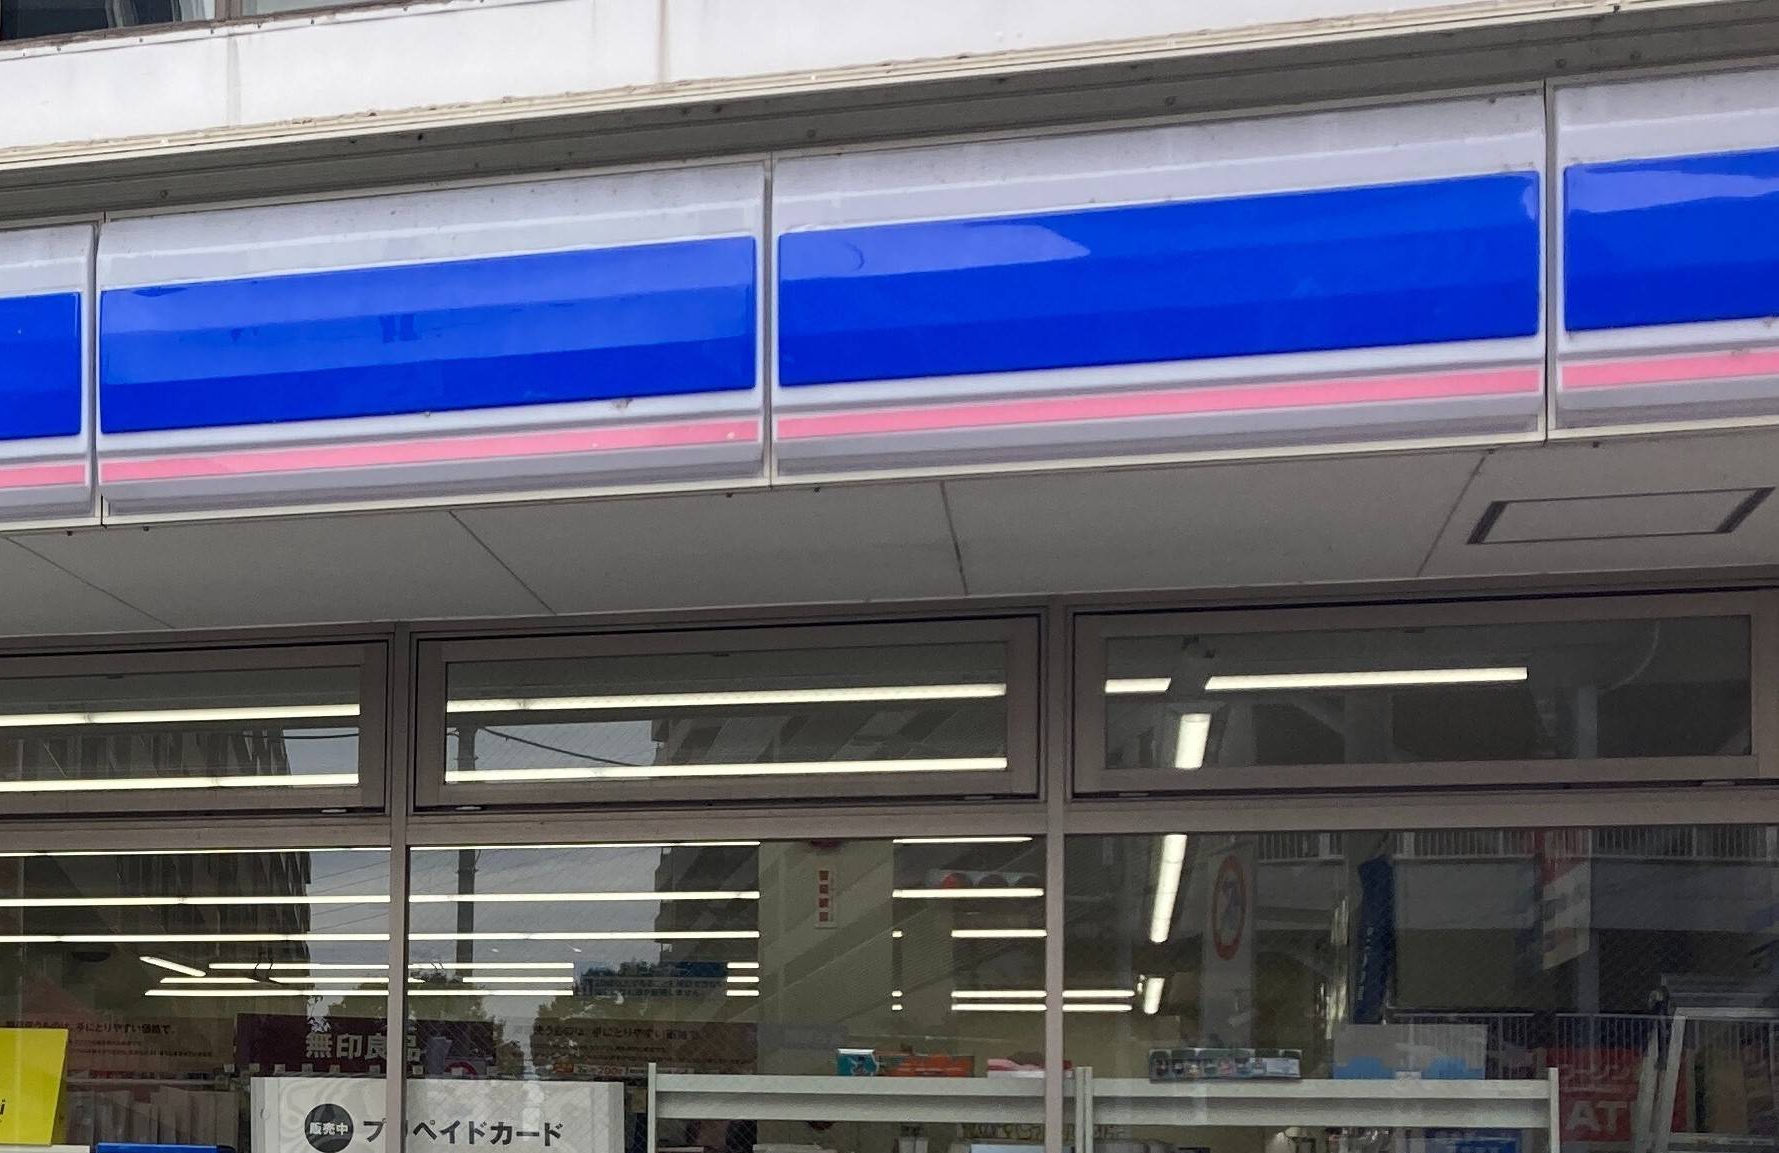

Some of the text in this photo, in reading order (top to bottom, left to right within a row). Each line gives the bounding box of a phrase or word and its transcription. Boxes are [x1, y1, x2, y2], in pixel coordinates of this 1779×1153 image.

[309, 1118, 564, 1147] 販売中 プペイドカード
